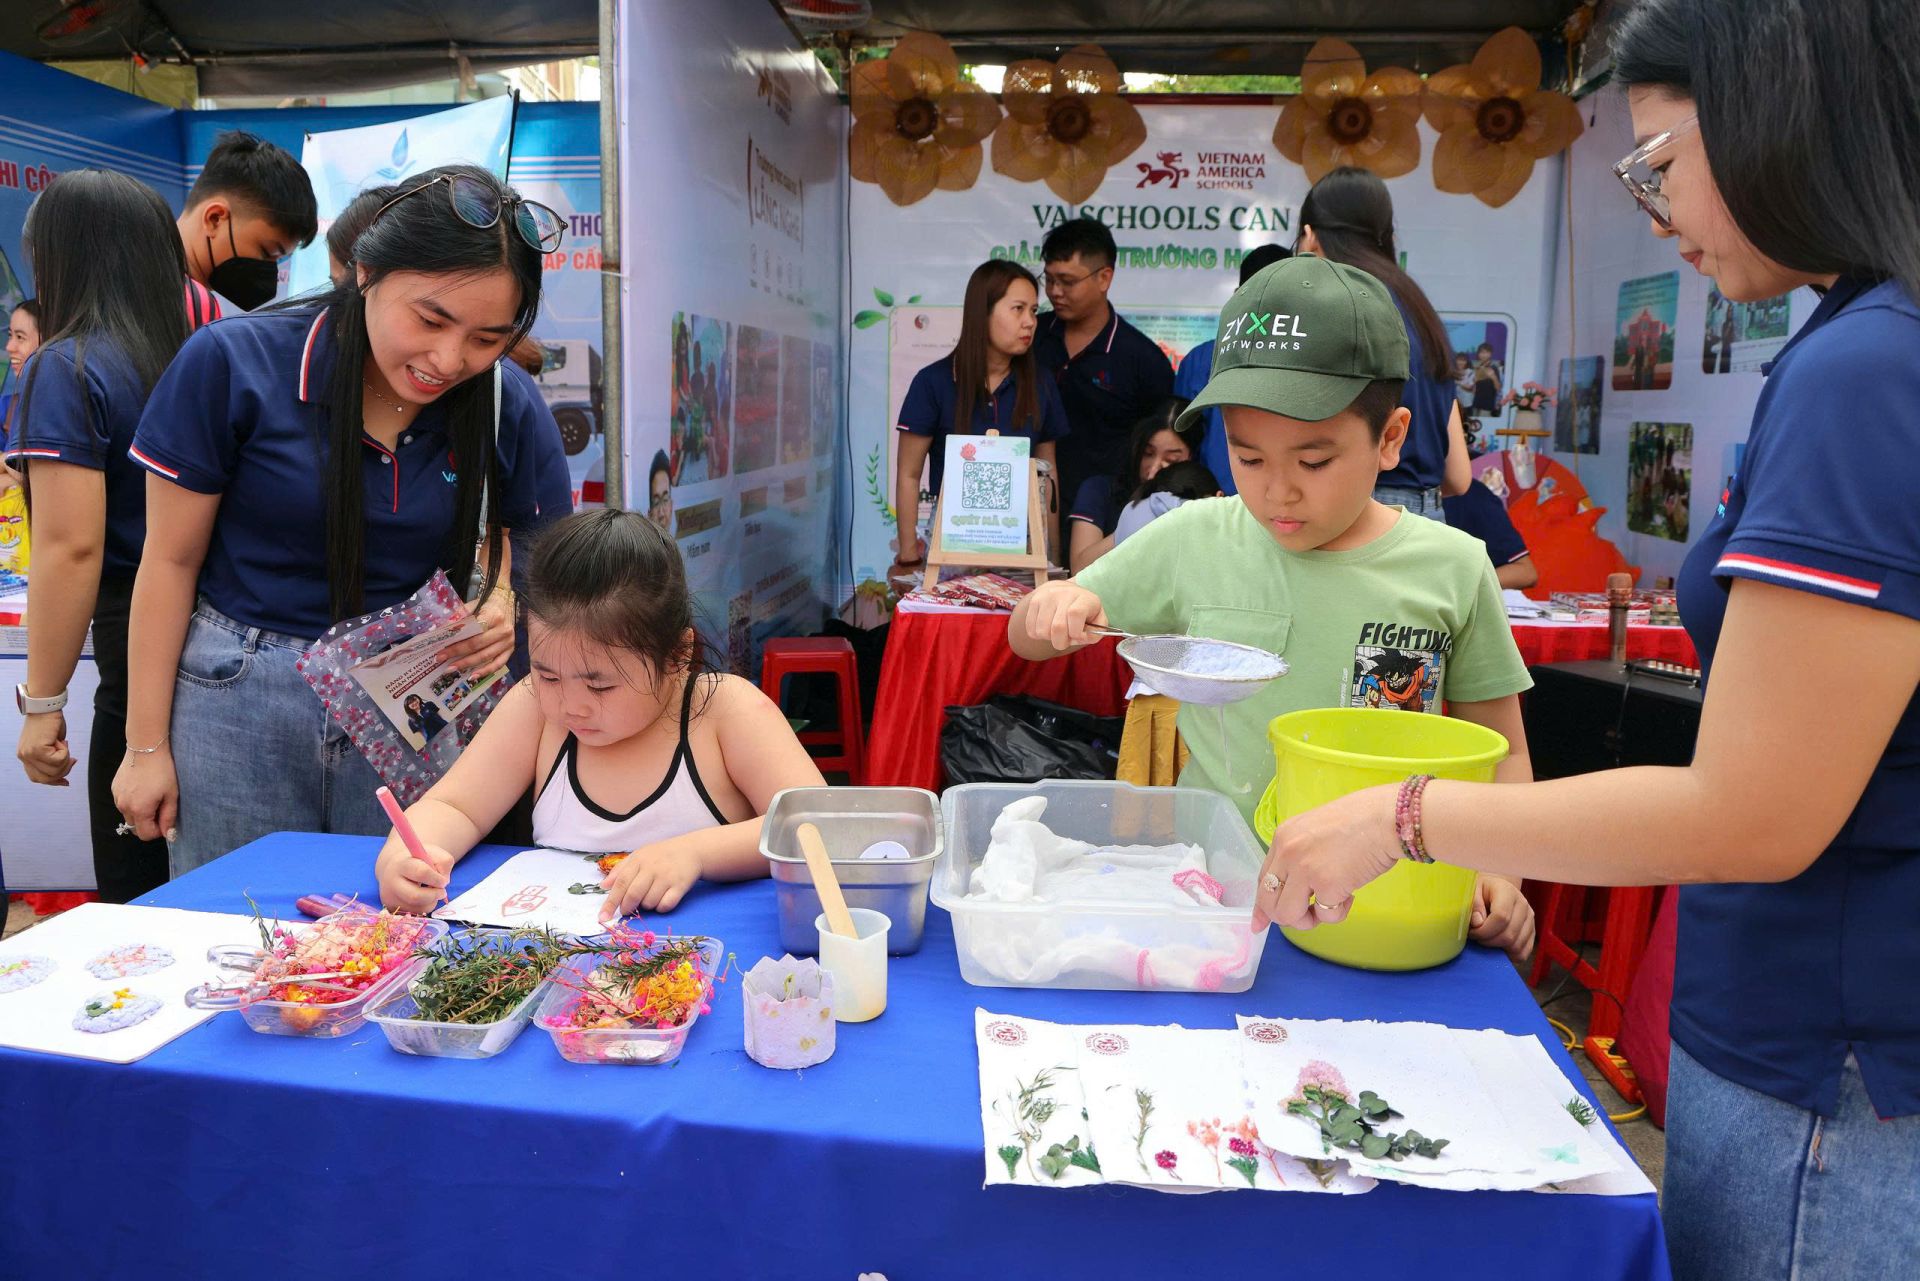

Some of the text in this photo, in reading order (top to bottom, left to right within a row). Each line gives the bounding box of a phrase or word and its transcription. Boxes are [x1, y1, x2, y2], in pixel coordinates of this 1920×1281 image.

[1197, 152, 1265, 165] VIETNAM
[1196, 166, 1266, 179] AMERICA
[1196, 180, 1254, 190] SCHOOLS
[1032, 204, 1291, 232] VA SCHOOLS CAN
[1117, 242, 1217, 270] TRƯỜNG
[1221, 312, 1307, 342] ZYXEL
[1220, 340, 1300, 355] NETWORKS
[1358, 622, 1452, 651] FIGHTING
